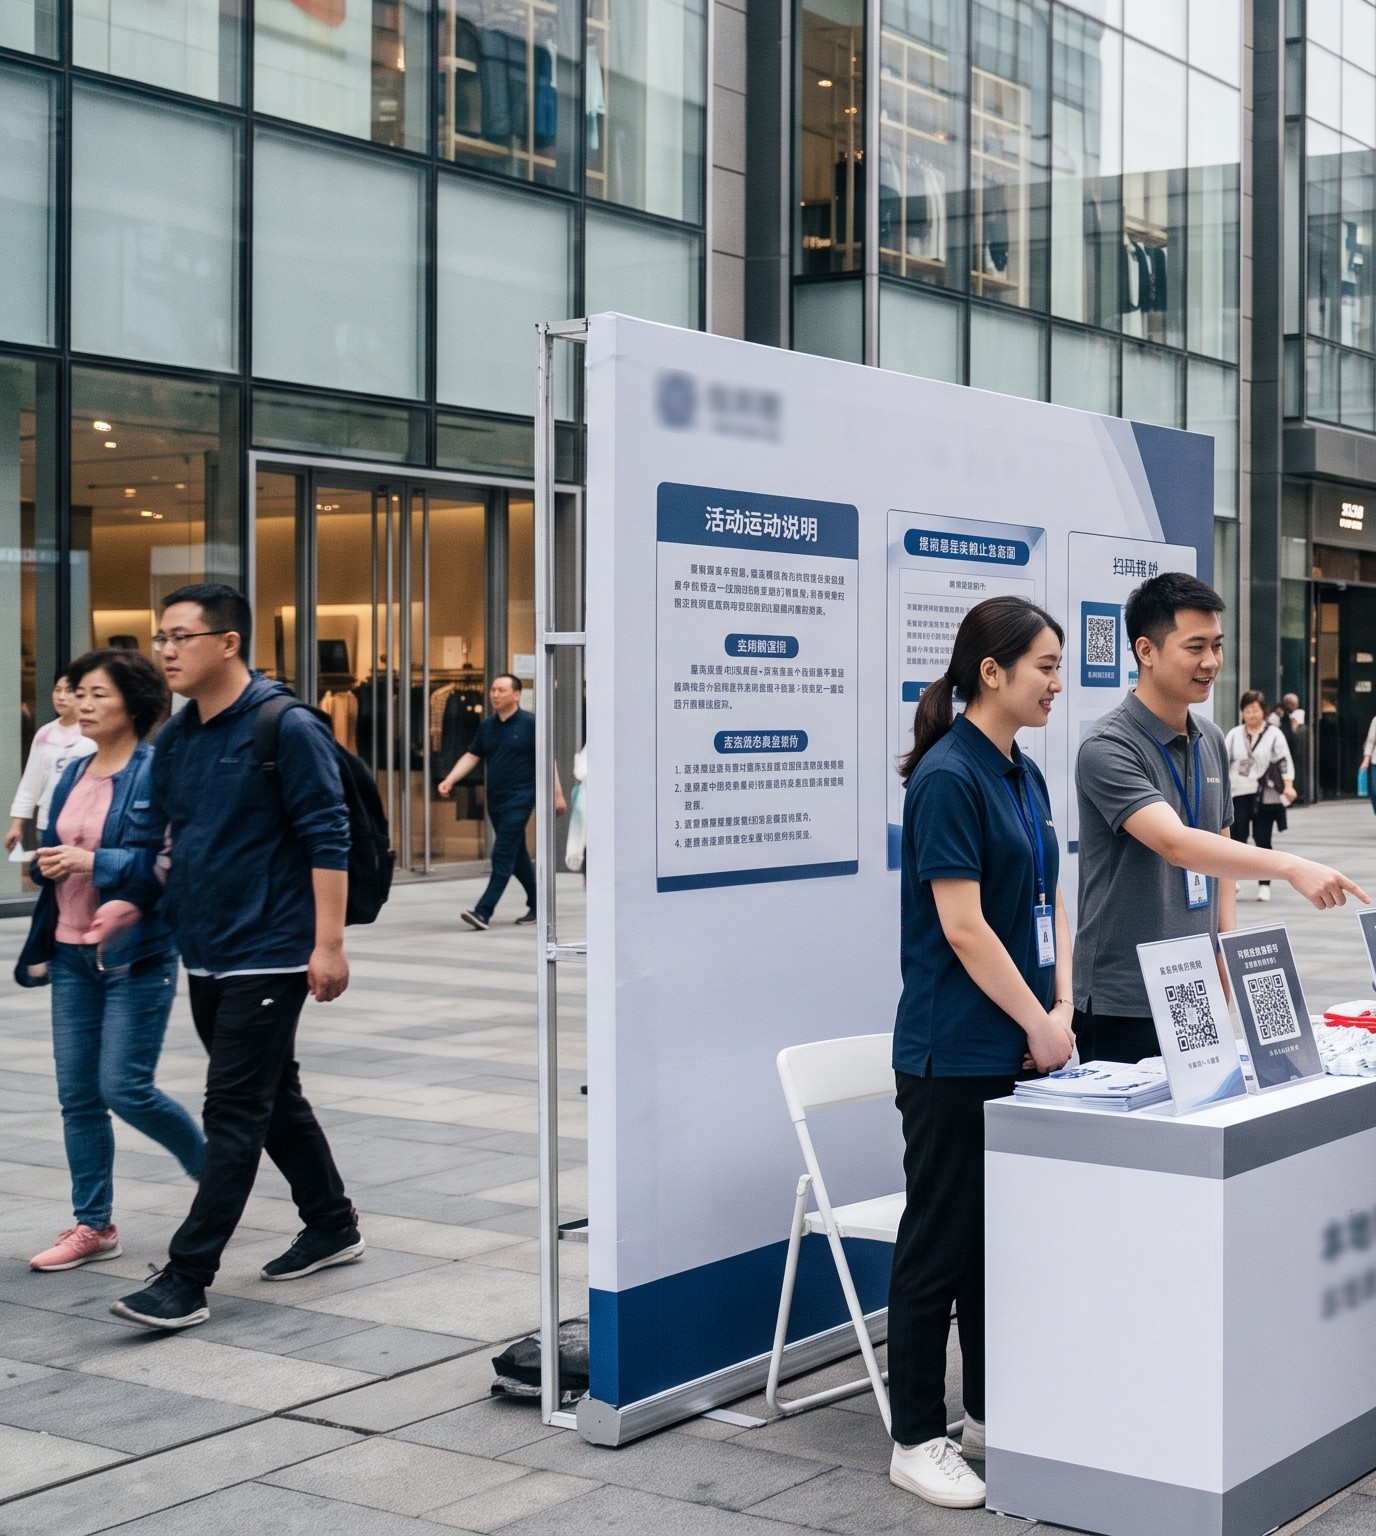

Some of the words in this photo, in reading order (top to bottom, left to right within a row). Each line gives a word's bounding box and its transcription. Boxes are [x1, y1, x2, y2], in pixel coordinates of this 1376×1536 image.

[705, 506, 818, 543] 活动运动说明
